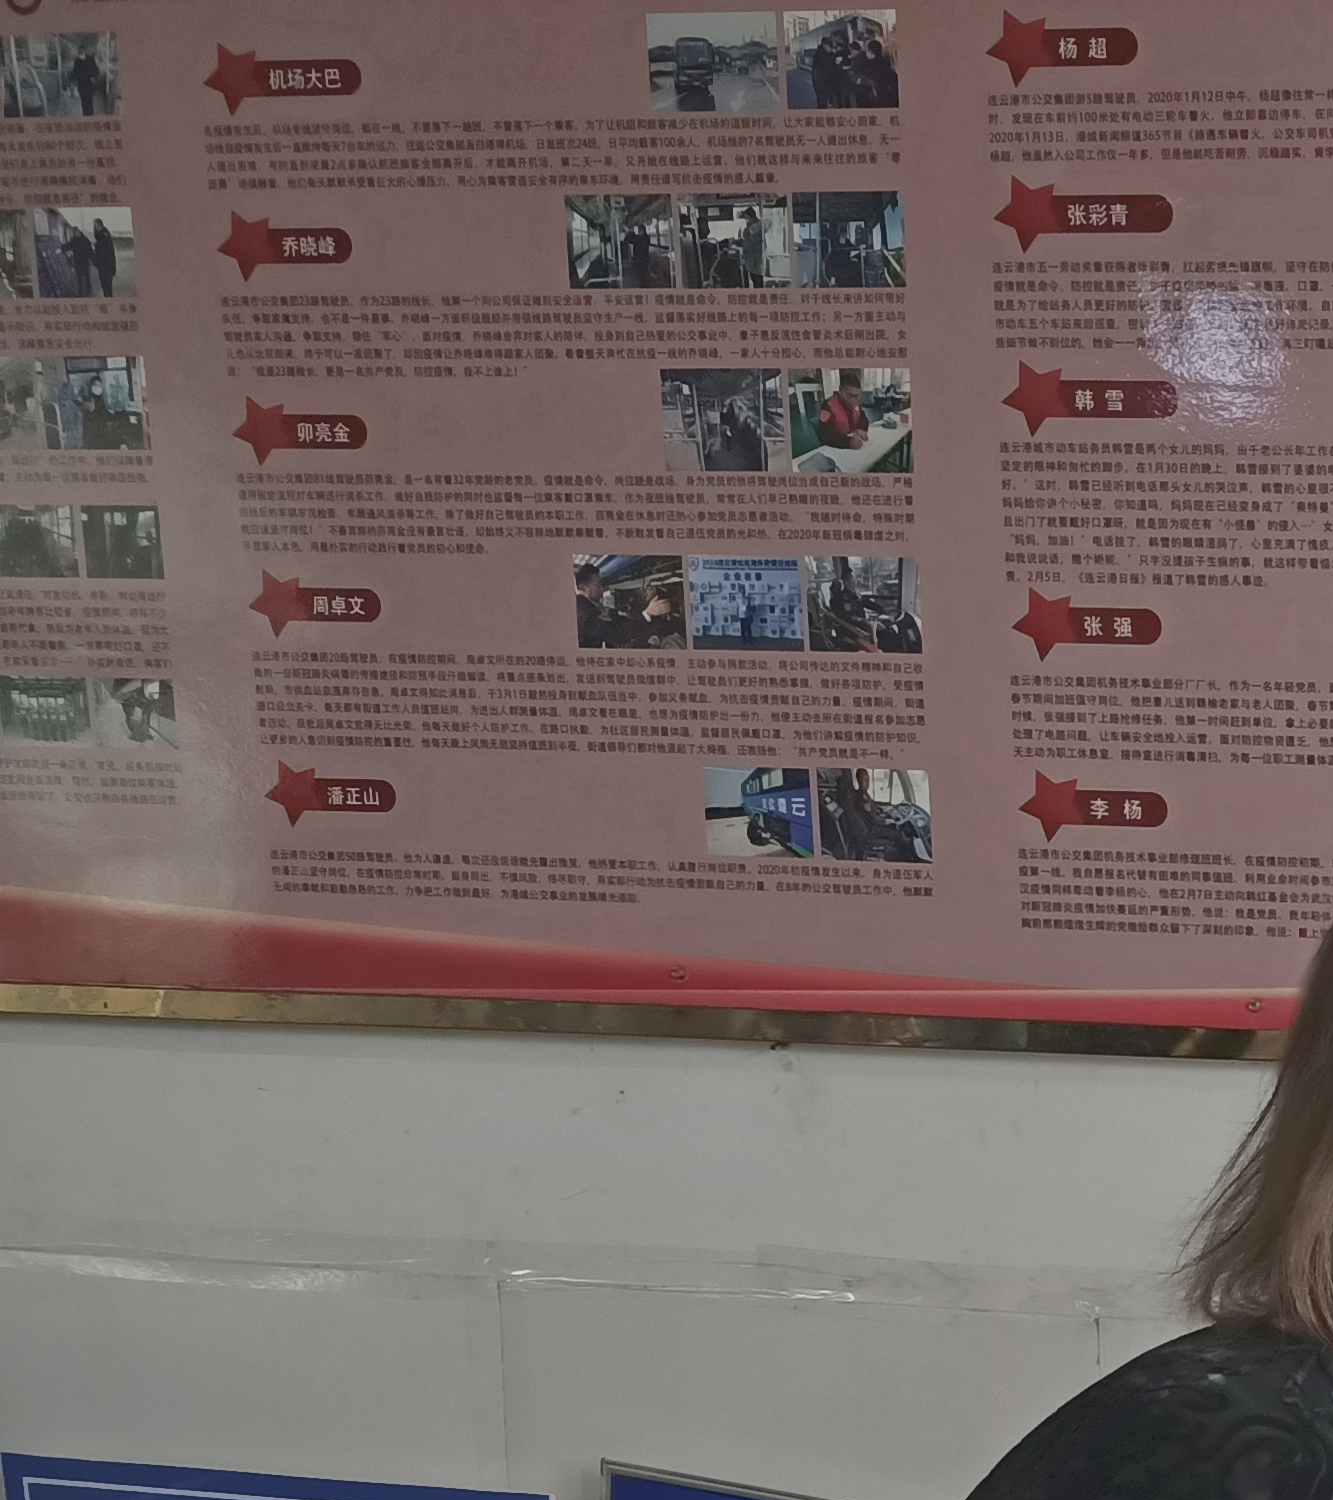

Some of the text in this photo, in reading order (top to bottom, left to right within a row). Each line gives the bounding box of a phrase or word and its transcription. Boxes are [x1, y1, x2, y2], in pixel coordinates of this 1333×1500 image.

[1058, 35, 1110, 62] 杨超
[267, 68, 343, 92] 机场大巴
[1066, 202, 1130, 229] 张彩青
[282, 235, 337, 259] 乔晓峰
[1074, 387, 1126, 414] 韩雪
[296, 421, 351, 444] 卯亮金
[311, 594, 367, 619] 周卓文
[1082, 614, 1134, 641] 张强
[326, 784, 382, 809] 潘正山
[1088, 797, 1144, 823] 李杨
